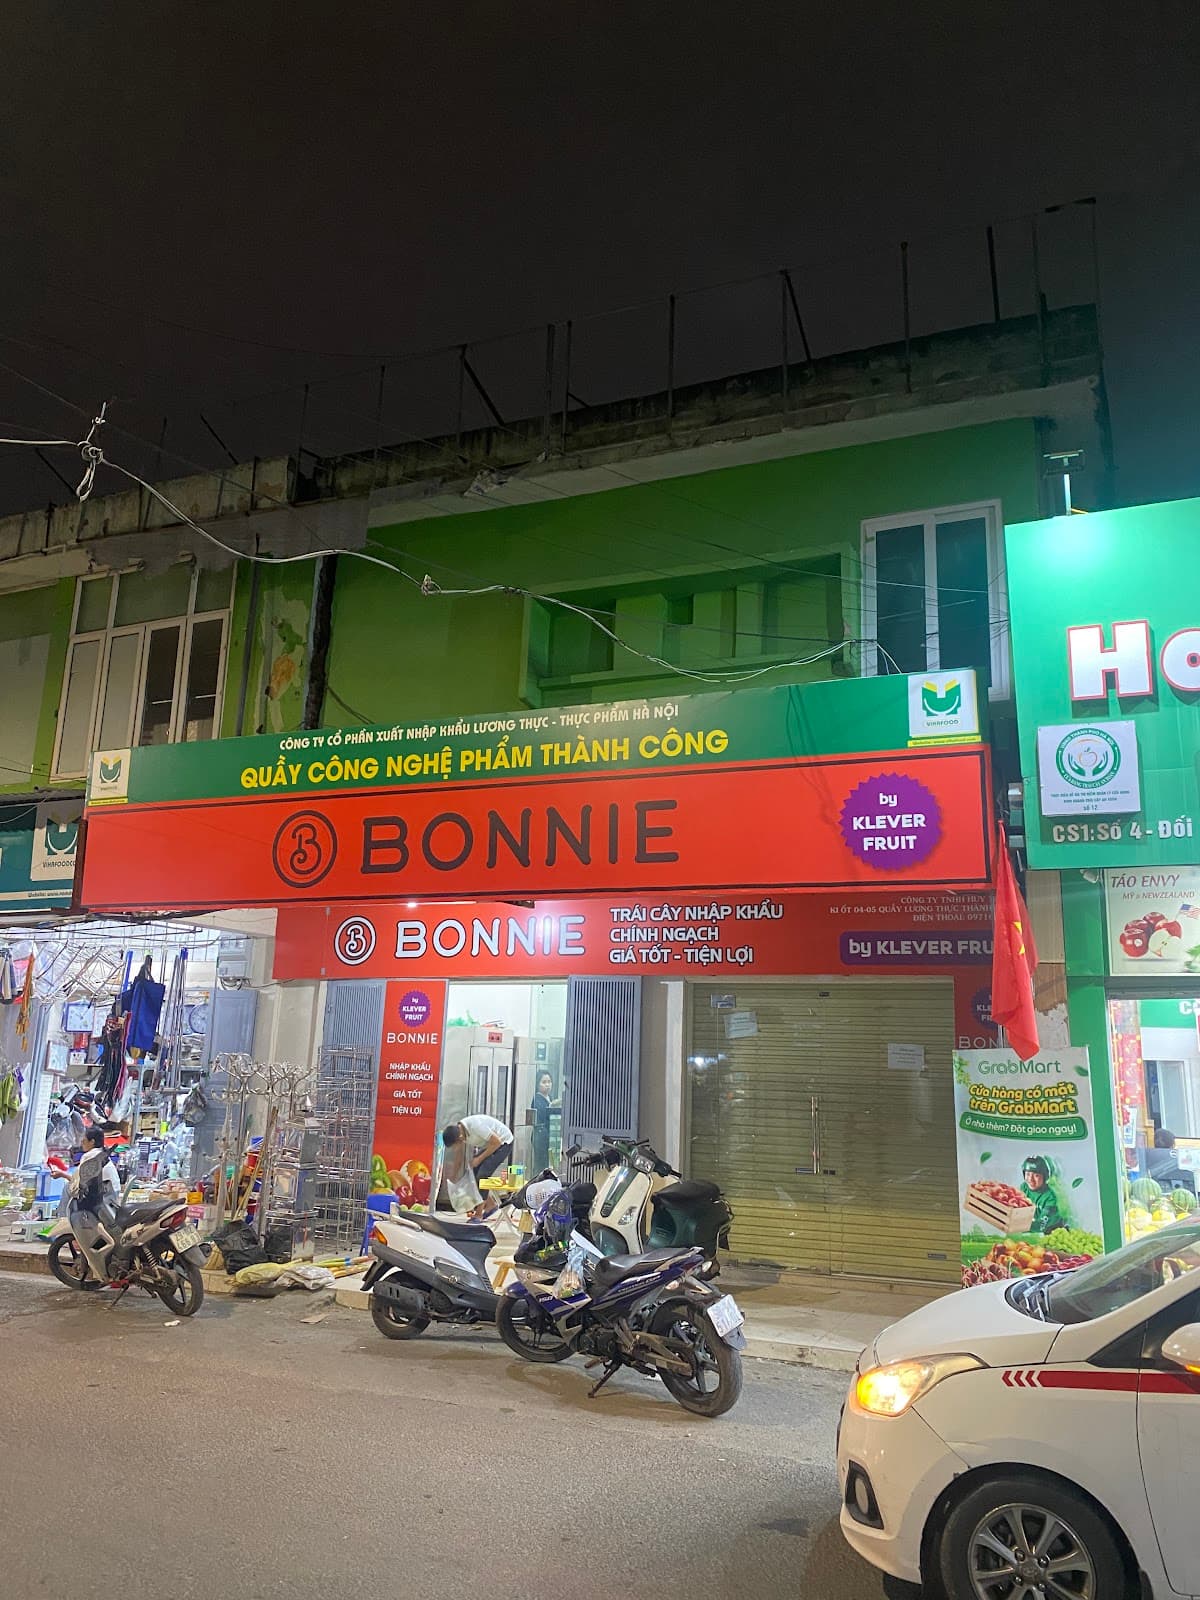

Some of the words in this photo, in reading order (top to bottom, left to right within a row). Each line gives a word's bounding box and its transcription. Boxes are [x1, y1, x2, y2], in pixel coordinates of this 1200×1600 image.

[280, 736, 310, 750] CÔNG
[312, 736, 325, 748] TY
[327, 728, 343, 746] CỔ
[344, 728, 374, 745] PHẦN
[376, 724, 405, 742] XUẤT
[406, 725, 437, 742] NHẬP
[439, 716, 471, 737] KHẨU
[473, 718, 516, 735] LƯƠNG
[519, 716, 549, 733] THỰC
[559, 712, 590, 729] THỰC
[593, 704, 629, 723] PHẨM
[632, 704, 650, 721] HÀ
[654, 702, 680, 721] NỘI
[240, 754, 303, 789] QUẦY
[307, 754, 379, 784] CÔNG
[386, 745, 453, 780] NGHỆ
[459, 735, 533, 772] PHẨM
[540, 734, 630, 767] THÀNH
[638, 727, 730, 760] CÔNG
[879, 792, 898, 807] by
[852, 813, 927, 831] KLEVER
[1130, 821, 1142, 840] 4
[360, 799, 680, 874] BONNIE
[863, 835, 918, 851] FRUIT
[1111, 873, 1137, 888] TÁO
[1141, 874, 1180, 888] ENVY
[901, 895, 925, 904] CÔNG
[928, 896, 938, 904] TY
[942, 895, 966, 904] TNHH
[609, 904, 648, 923] TRÁI
[650, 904, 682, 921] CÂY
[685, 902, 733, 924] NHẬP
[735, 898, 784, 920] KHẨU
[854, 905, 877, 914] 04-05
[395, 915, 586, 959] BONNIE
[609, 924, 659, 943] CHÍNH
[662, 926, 720, 945] NGẠCH
[638, 943, 672, 963] TỐT
[684, 945, 723, 966] TIỆN
[726, 945, 754, 966] LỢI
[848, 938, 872, 957] by
[876, 940, 953, 955] KLEVER
[386, 1032, 438, 1044] BONNIE
[978, 1060, 1062, 1075] GrabMart
[385, 1071, 408, 1080] CHÍNH
[408, 1073, 434, 1083] NGẠCH
[407, 1089, 423, 1099] TỐT
[969, 1084, 990, 1097] Cửa
[991, 1086, 1024, 1101] hàng
[1025, 1086, 1042, 1099] có
[1044, 1082, 1076, 1099] mặt
[391, 1104, 409, 1115] TIỆN
[969, 1097, 996, 1112] trên
[998, 1099, 1076, 1115] GrabMart
[972, 1119, 985, 1128] nhà
[986, 1121, 1010, 1132] thèm?
[1010, 1124, 1027, 1135] Đặt
[1027, 1125, 1047, 1136] giao
[1048, 1123, 1077, 1136] ngay!
